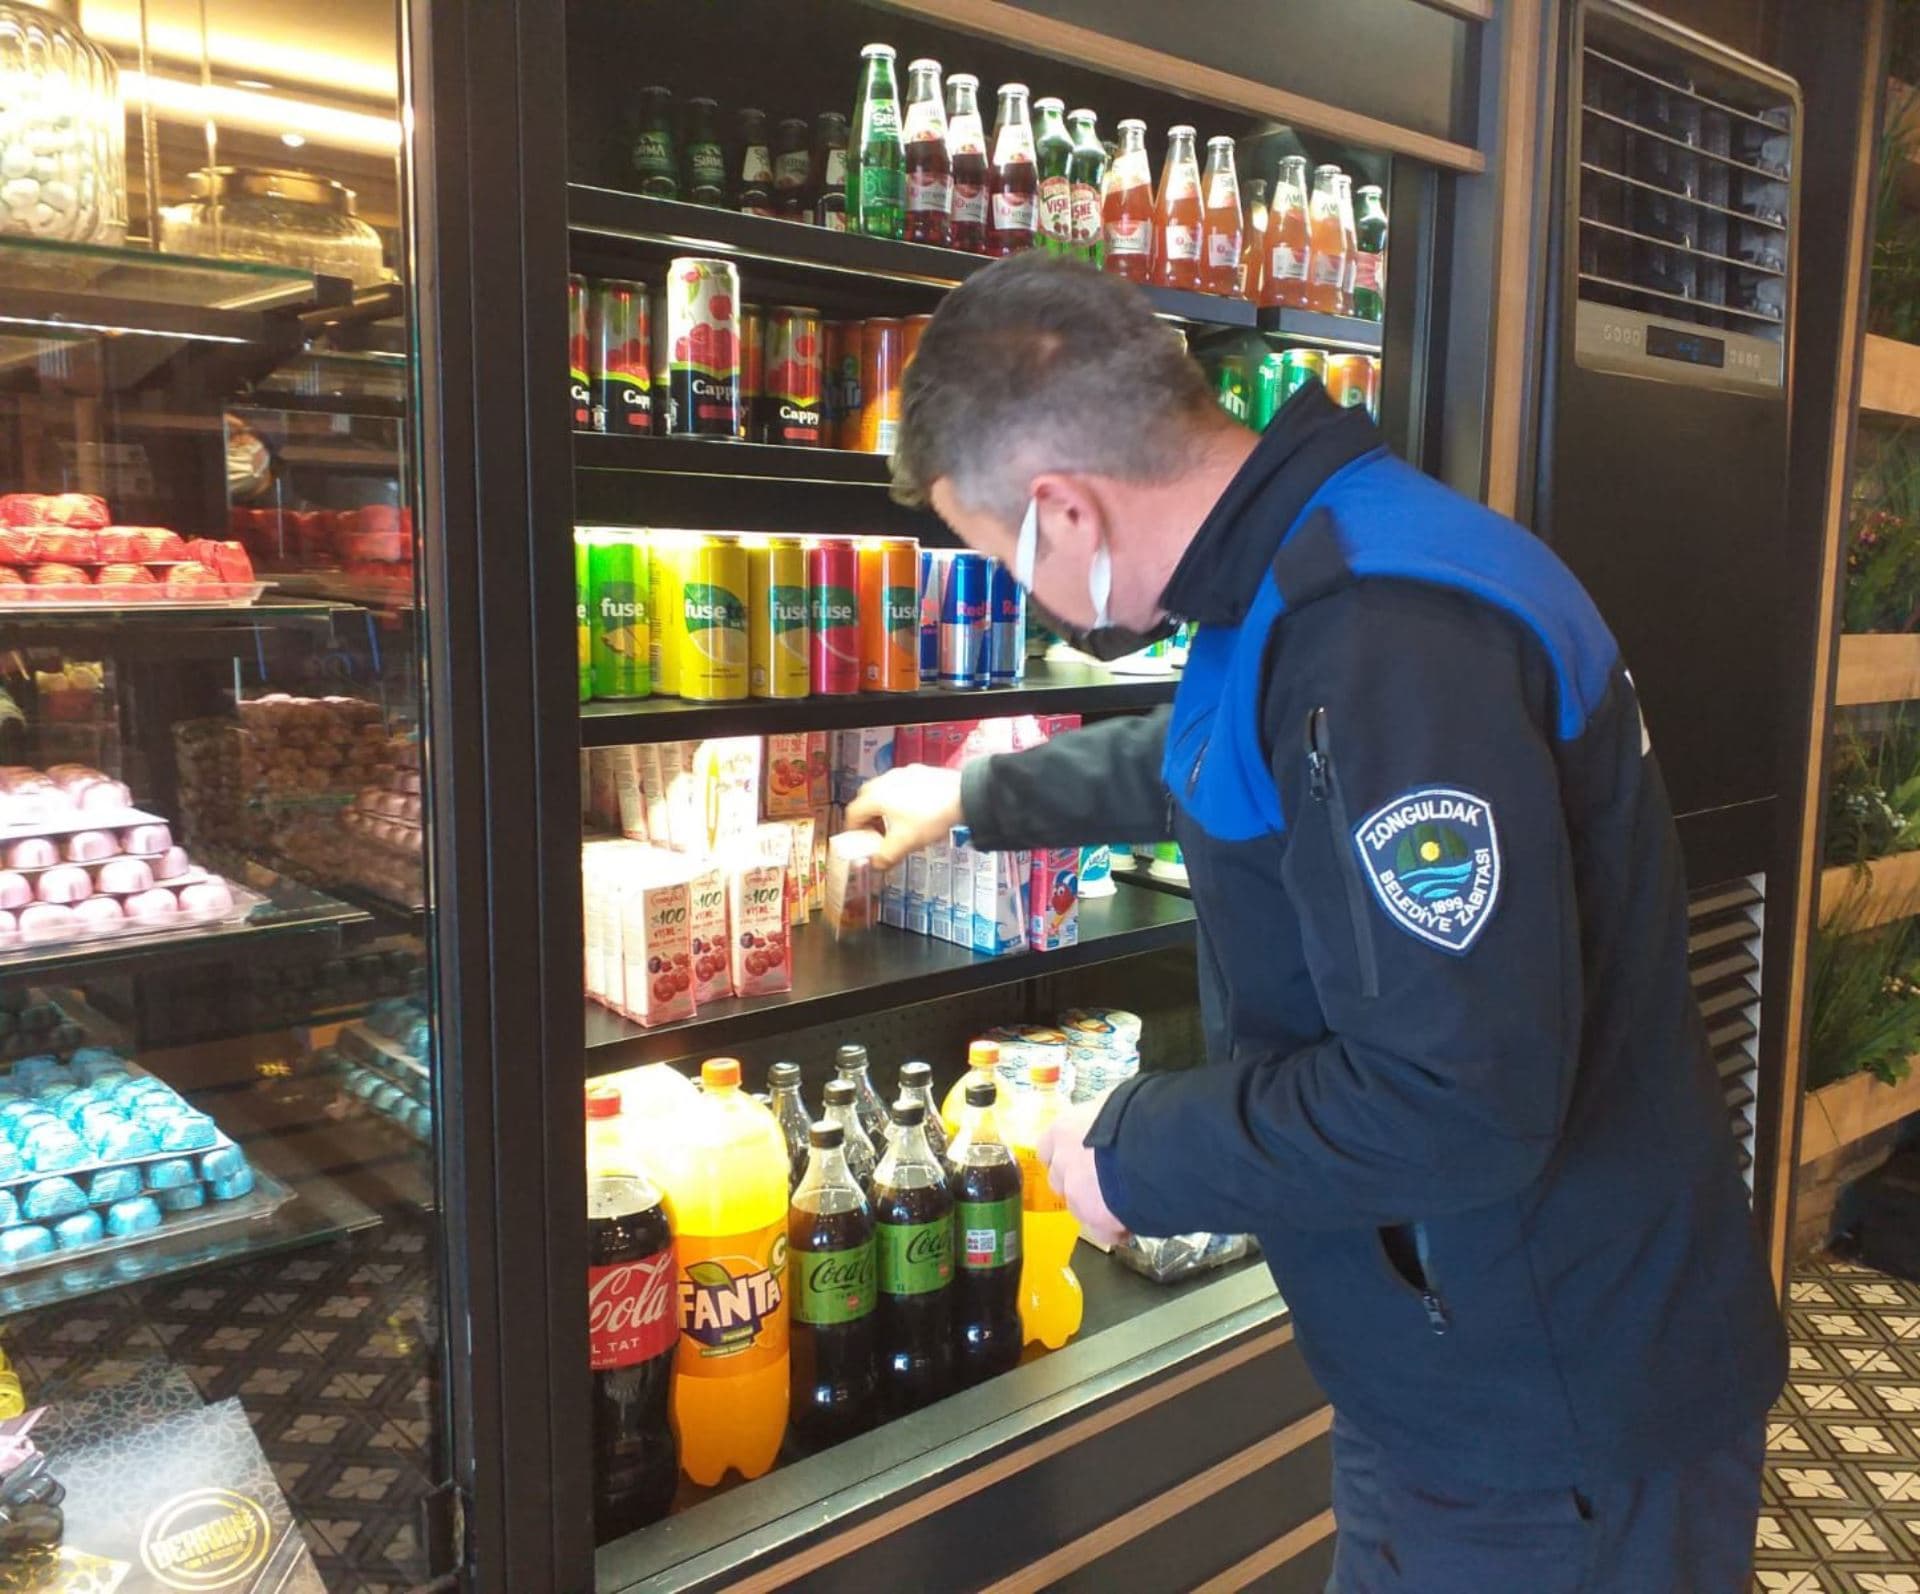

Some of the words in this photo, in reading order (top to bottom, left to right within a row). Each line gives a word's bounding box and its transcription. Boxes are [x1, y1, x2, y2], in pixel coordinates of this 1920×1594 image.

[779, 405, 820, 425] Cappy
[601, 597, 645, 618] fuse
[684, 598, 728, 620] fuse
[811, 600, 853, 619] fuse
[1365, 800, 1482, 850] ZONGULDAK
[1379, 869, 1453, 933] BELEDİYE
[1454, 847, 1492, 927] ZABITASI
[1430, 896, 1464, 915] 1899
[677, 1270, 781, 1331] FANTA
[607, 1337, 641, 1353] TAT
